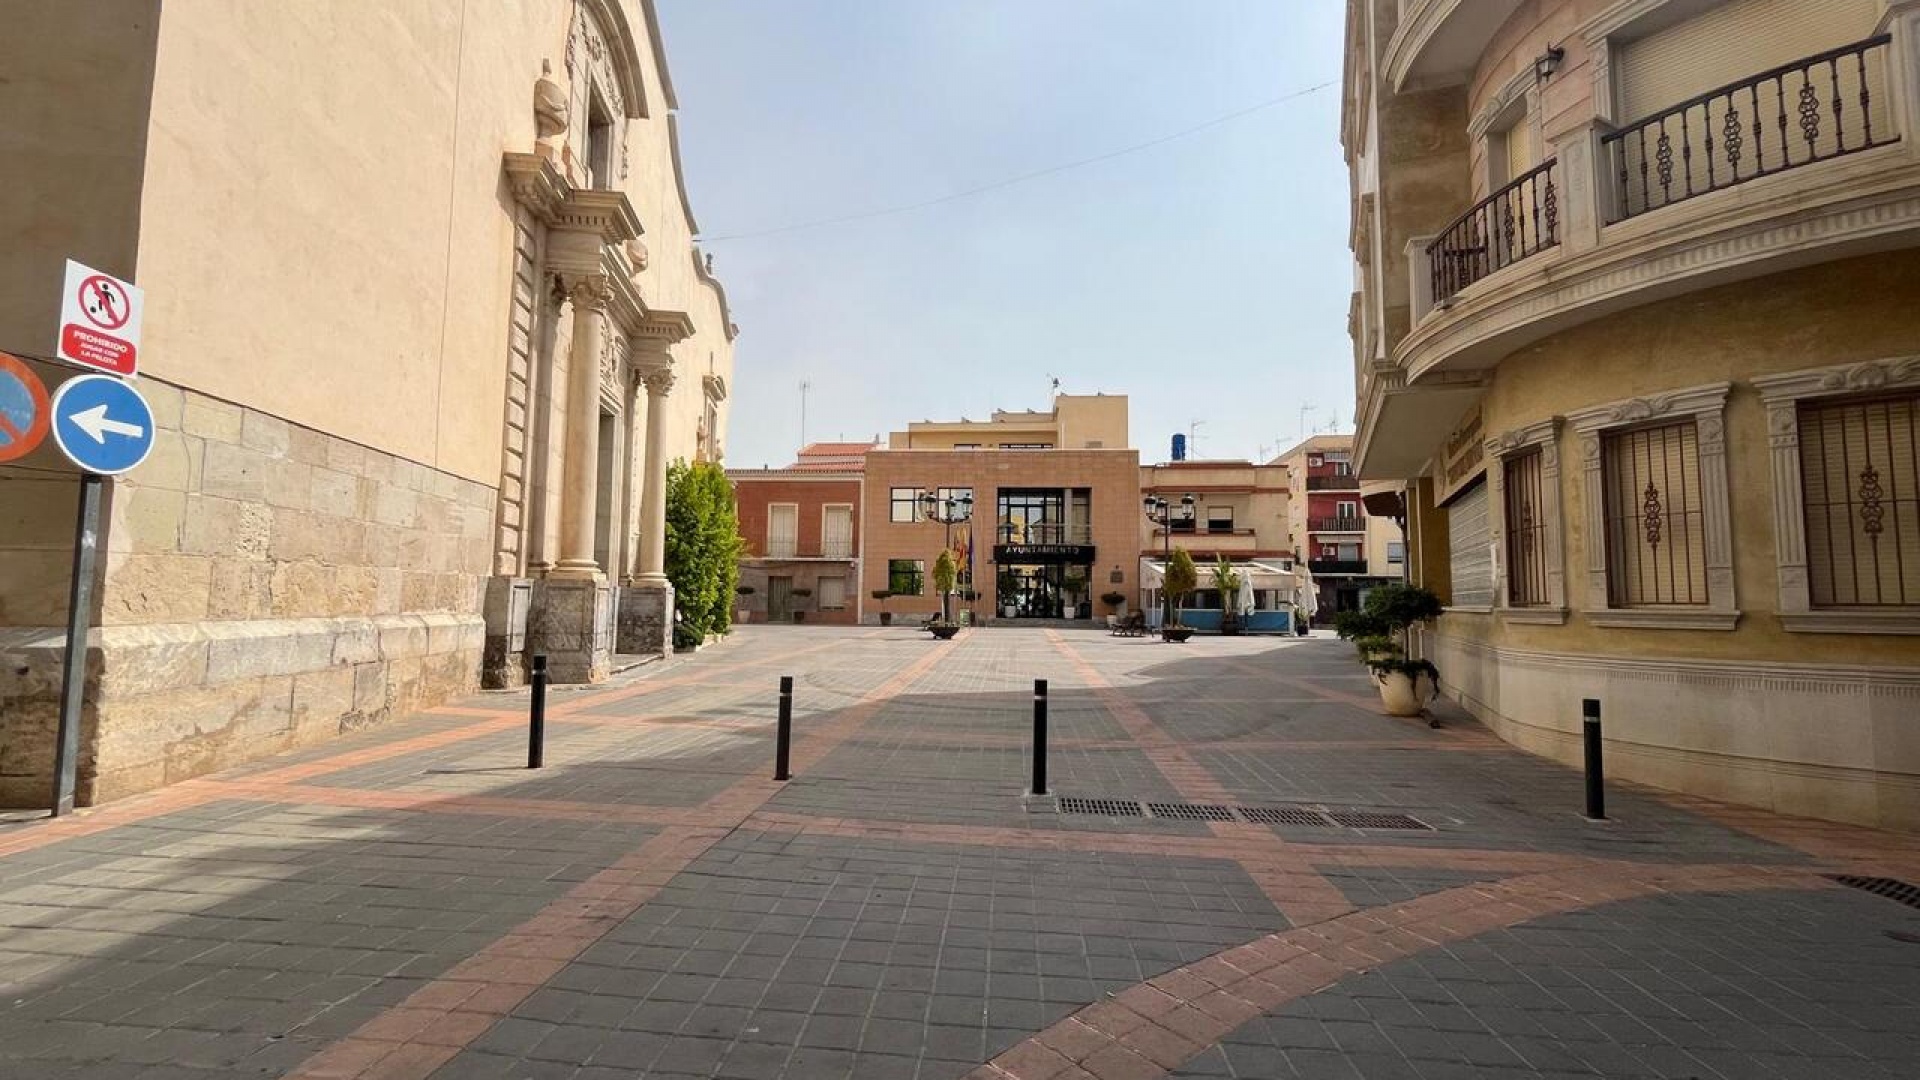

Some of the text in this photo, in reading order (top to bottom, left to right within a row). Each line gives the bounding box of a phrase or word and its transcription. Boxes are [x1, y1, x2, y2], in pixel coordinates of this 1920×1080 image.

[74, 330, 127, 353] PROHIBIDO
[80, 350, 118, 366] LA PELOTA
[104, 349, 119, 358] CON
[1006, 546, 1080, 555] AYUNTAMIENTO
